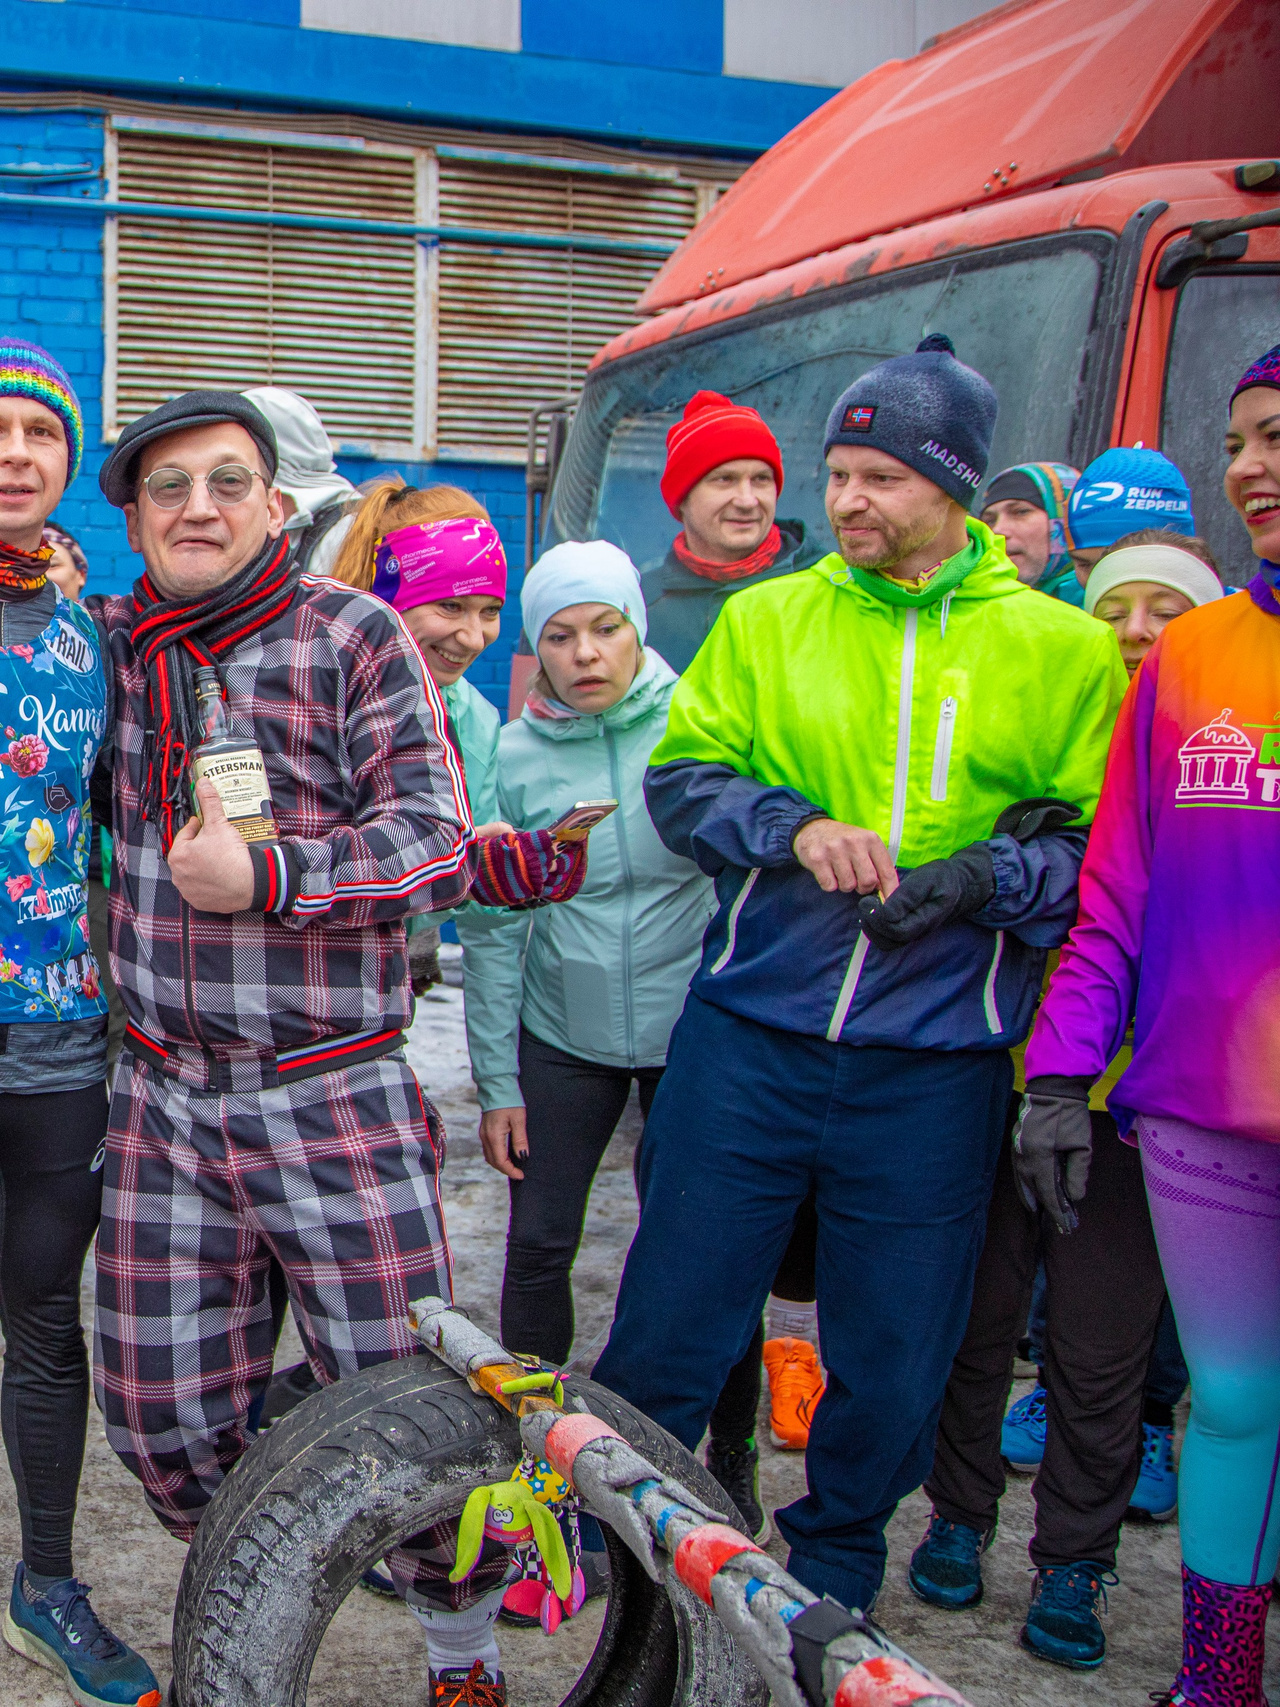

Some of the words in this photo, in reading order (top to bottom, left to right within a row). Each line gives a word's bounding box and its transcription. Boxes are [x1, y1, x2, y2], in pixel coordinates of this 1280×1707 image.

[1127, 487, 1163, 499] RUN
[1123, 498, 1188, 511] ZEPPELIN
[203, 762, 263, 778] STEERSMAN
